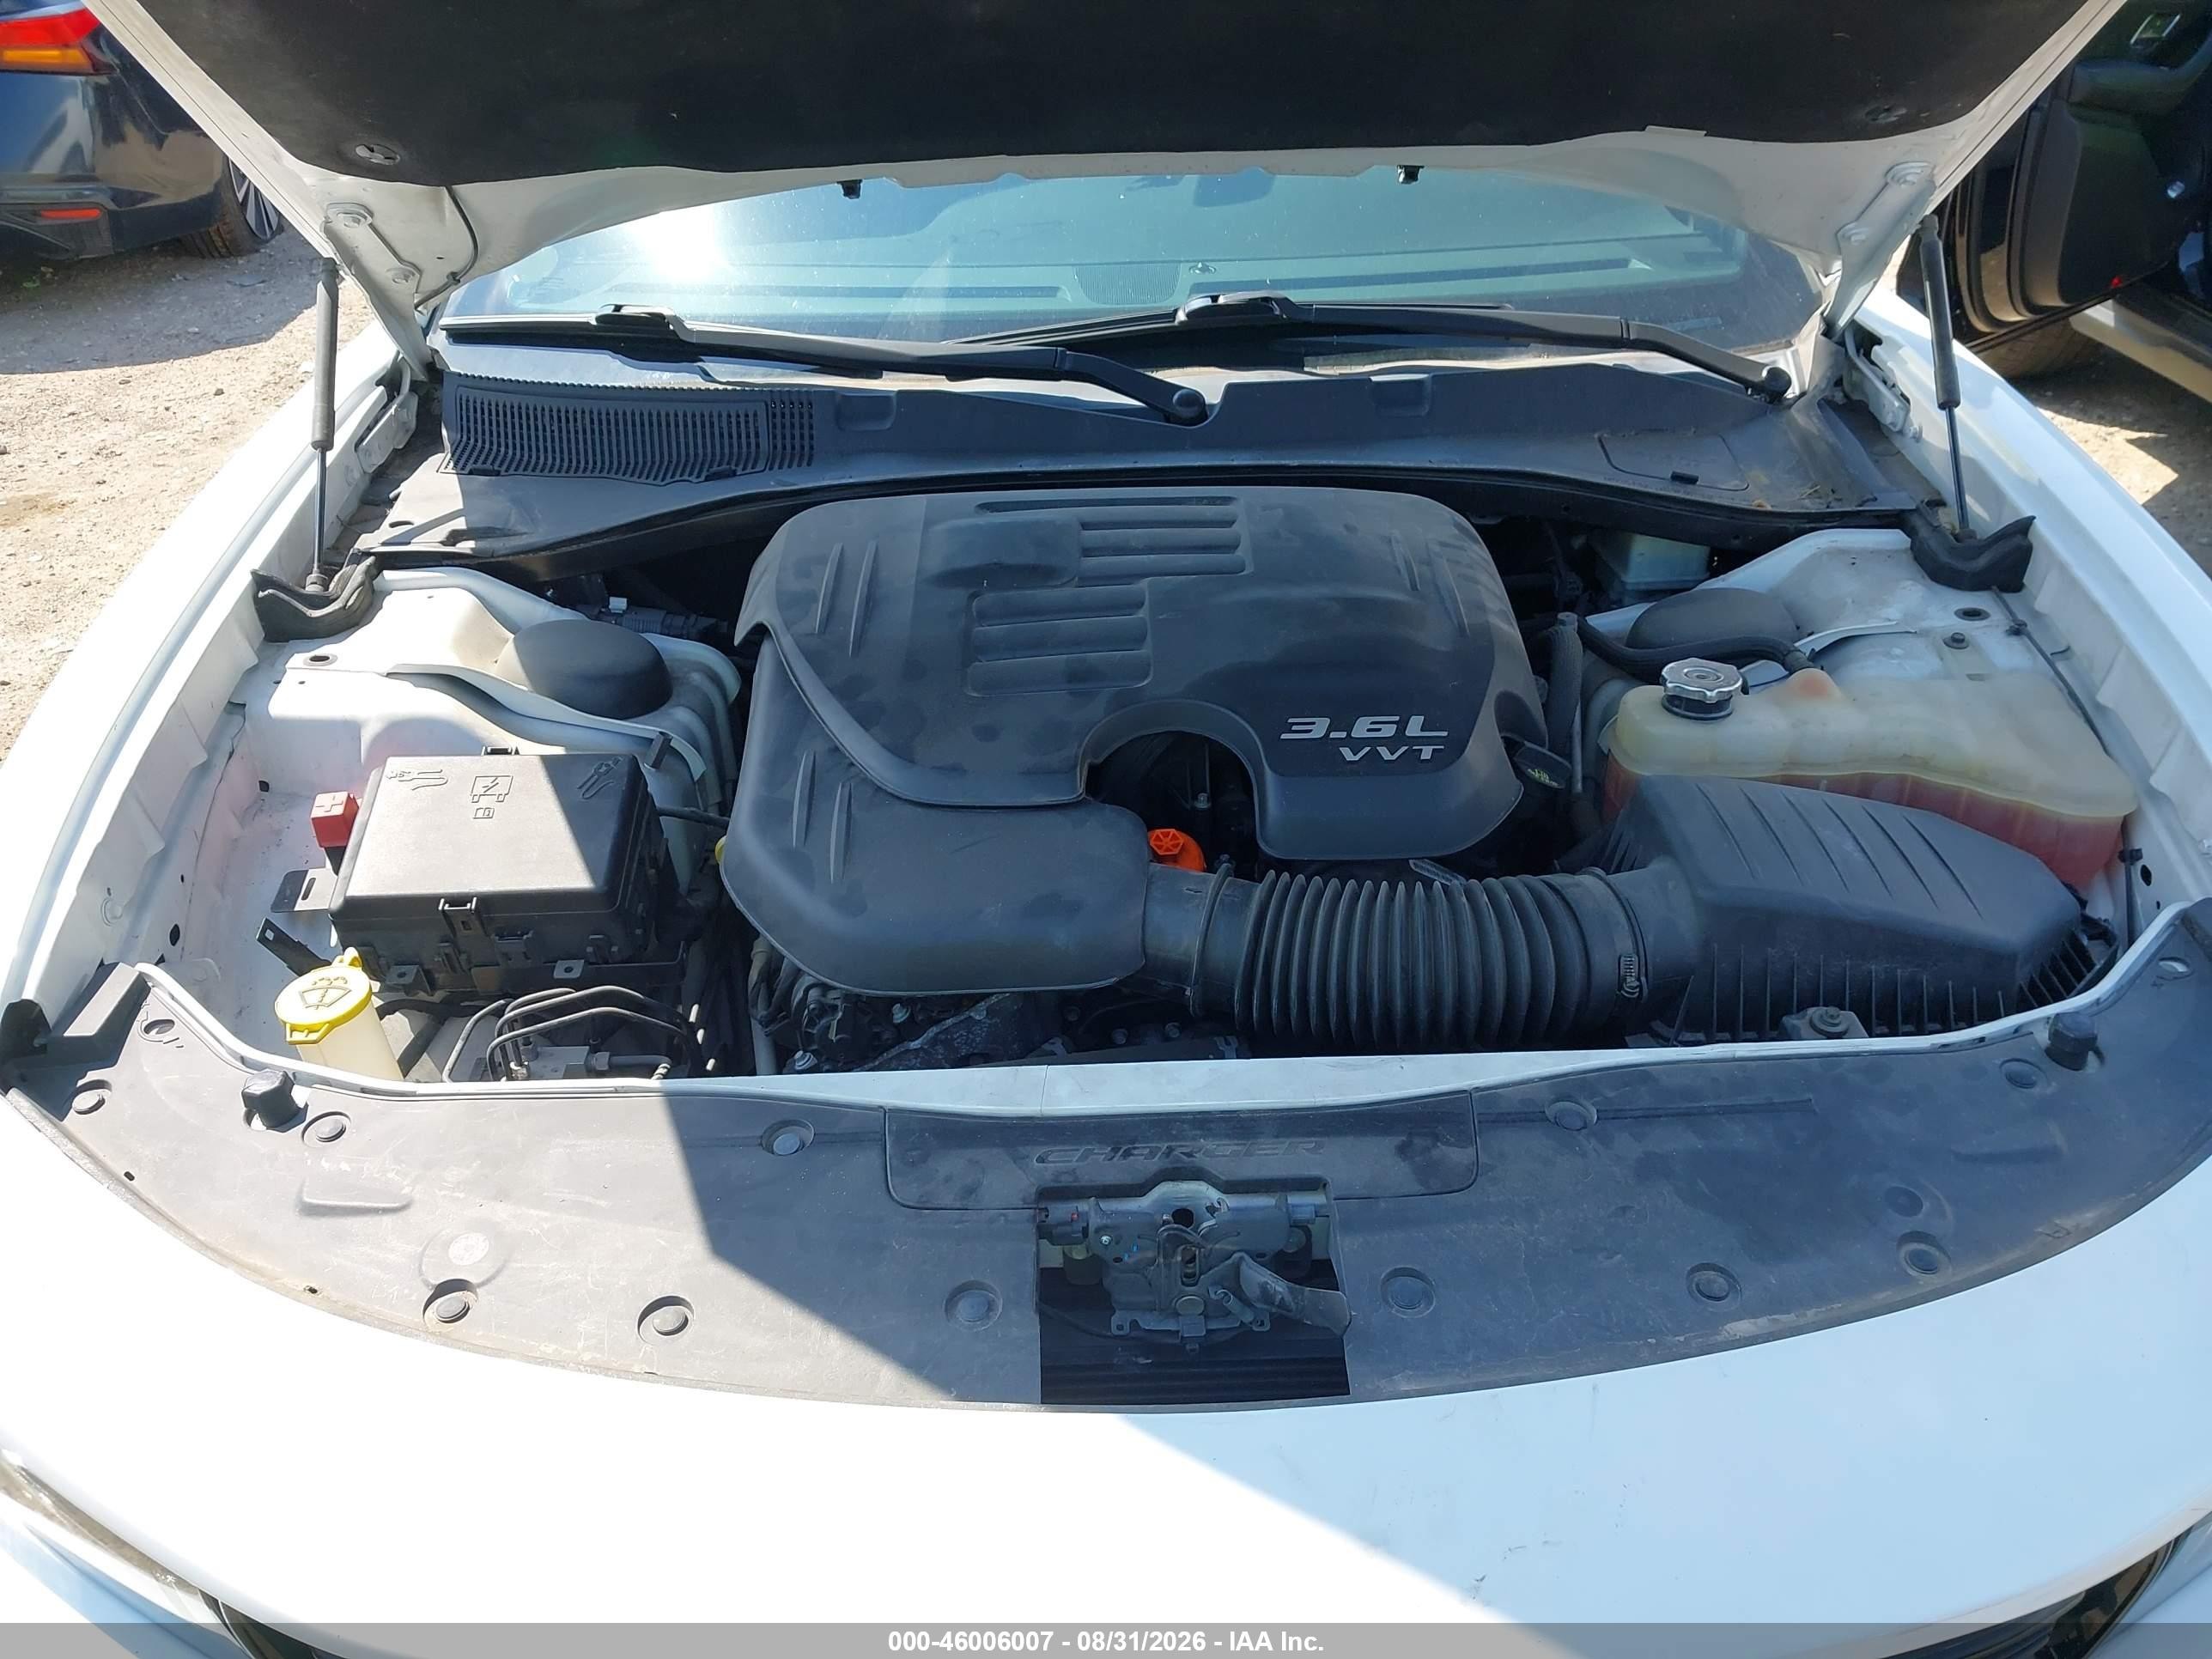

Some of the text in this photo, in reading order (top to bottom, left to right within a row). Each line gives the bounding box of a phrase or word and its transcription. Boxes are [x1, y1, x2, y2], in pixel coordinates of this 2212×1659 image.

[1279, 715, 1449, 739] 3.6L
[1339, 745, 1445, 761] VVT
[1034, 1138, 1328, 1165] CHARGER
